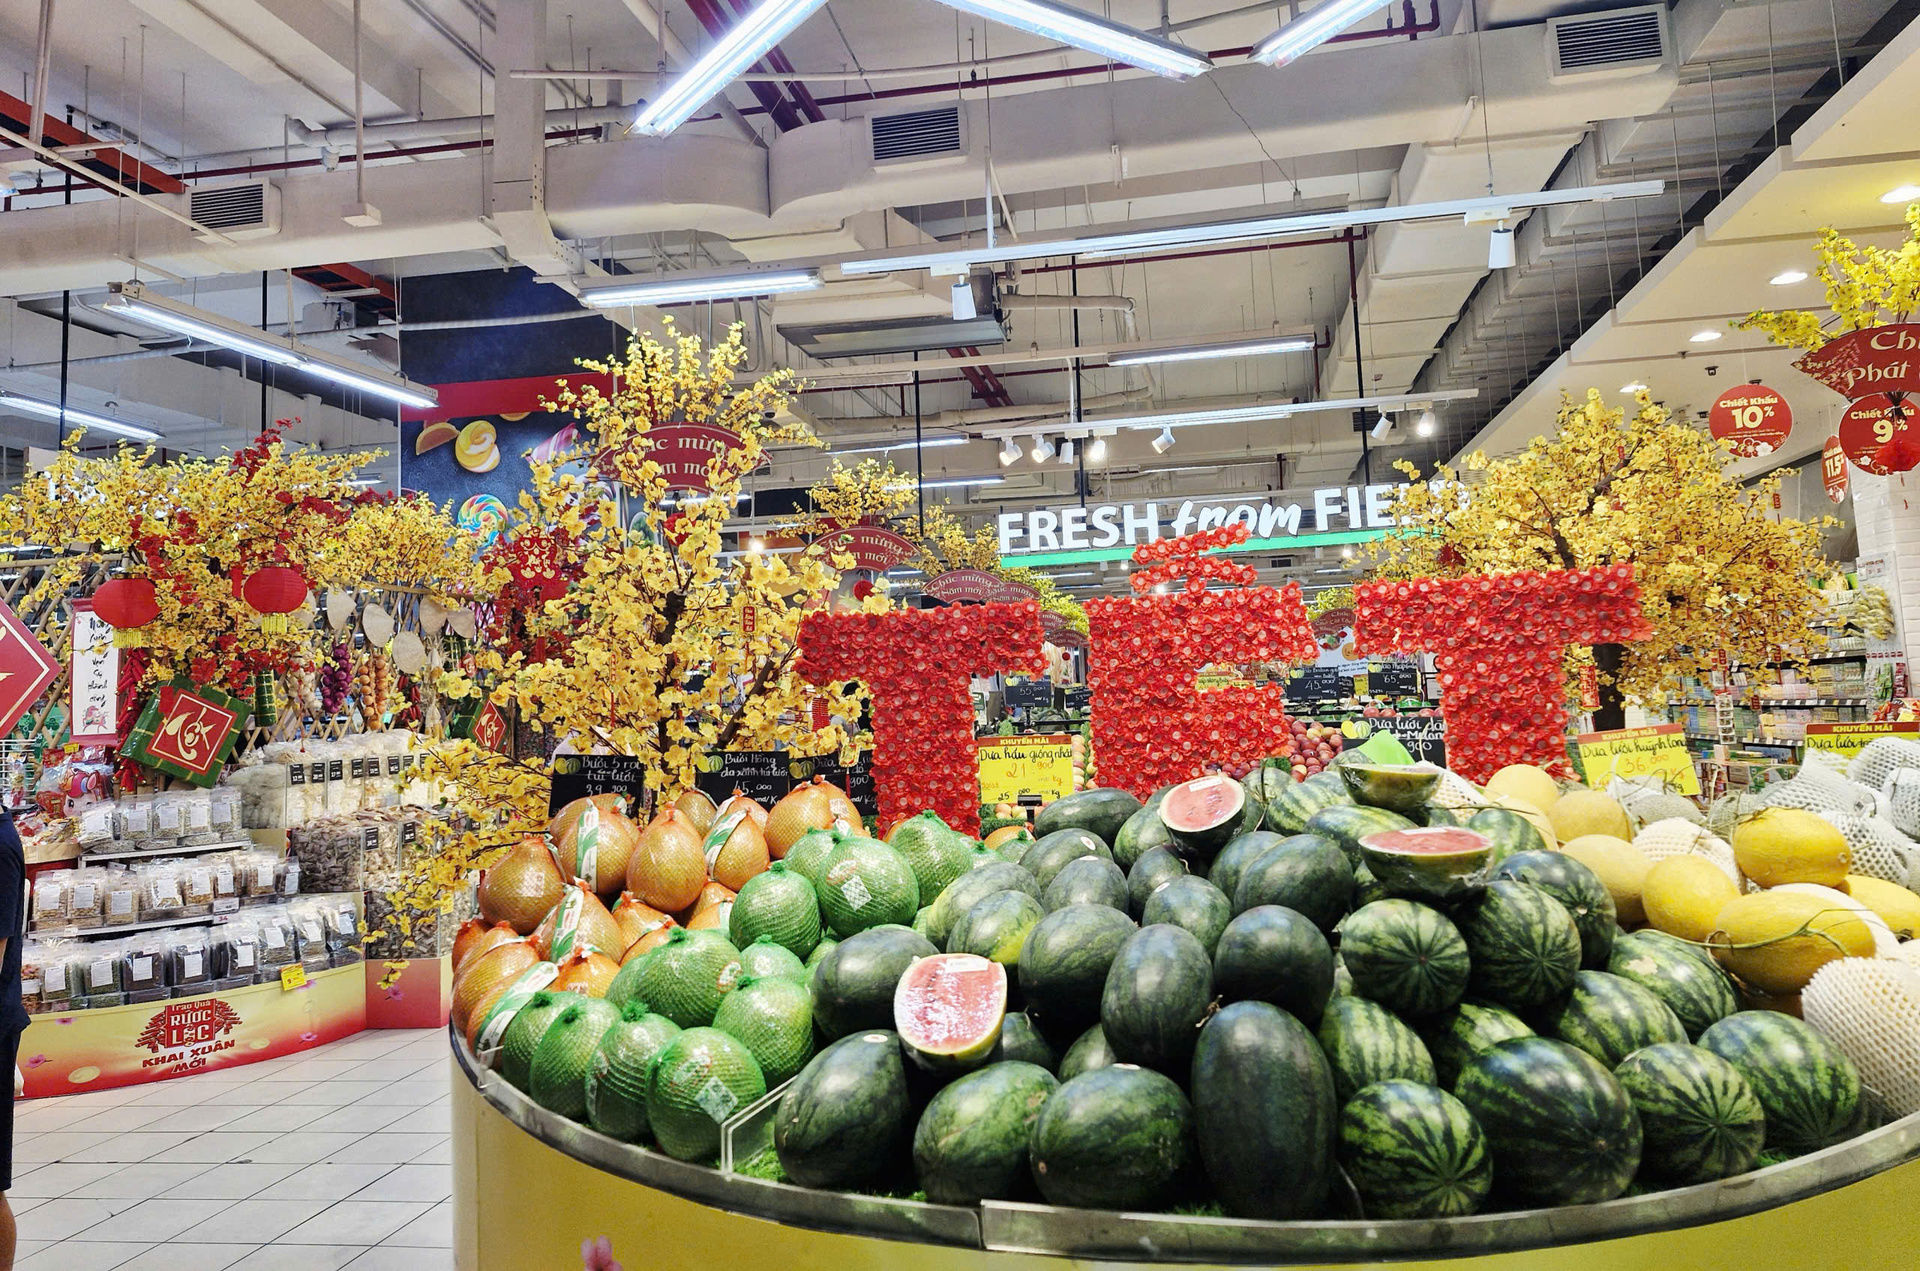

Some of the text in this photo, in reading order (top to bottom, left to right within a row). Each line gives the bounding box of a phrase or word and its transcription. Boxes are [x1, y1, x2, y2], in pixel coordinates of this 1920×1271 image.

[1719, 394, 1778, 408] Chiết Khấu
[1731, 405, 1775, 429] 10%
[1850, 407, 1882, 420] Chiết
[1872, 419, 1908, 444] 9%
[1000, 502, 1160, 554] FRESH
[1170, 499, 1302, 540] from
[612, 757, 621, 769] 5
[980, 748, 1002, 762] Dưa
[142, 1040, 236, 1068] KHAI XUÂN
[171, 1056, 207, 1074] MỚI
